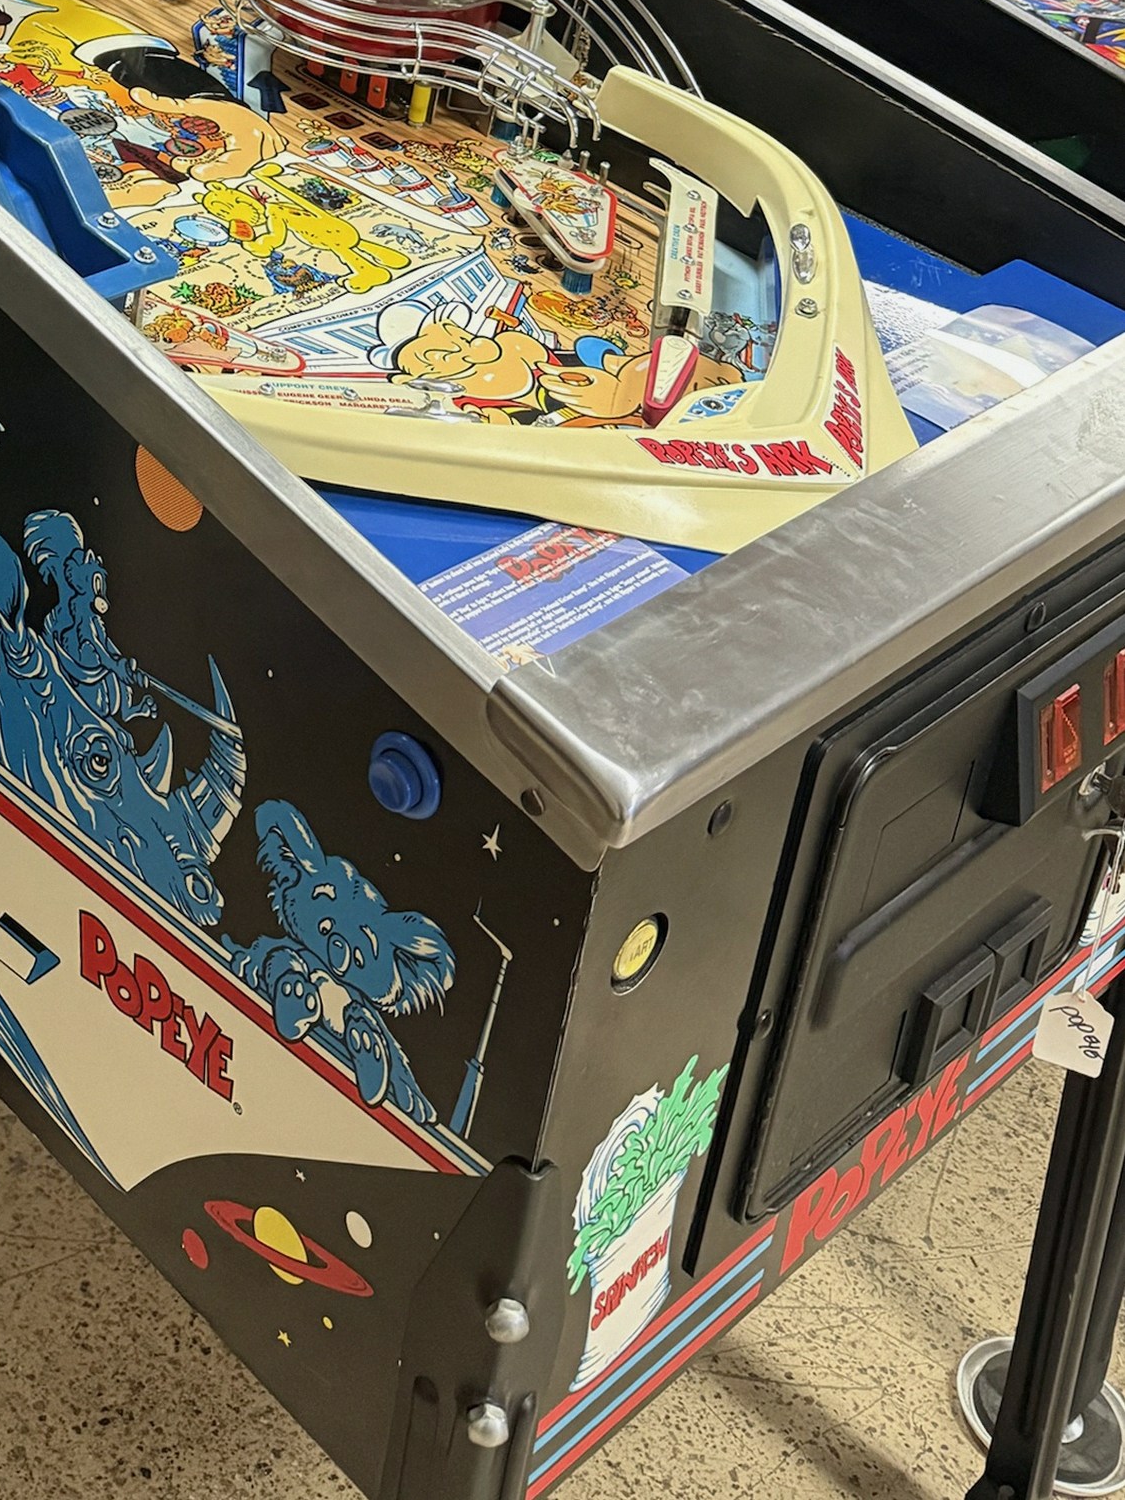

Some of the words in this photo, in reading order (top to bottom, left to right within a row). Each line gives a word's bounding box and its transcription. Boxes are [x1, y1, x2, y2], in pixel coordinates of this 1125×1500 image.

[63, 112, 103, 125] SAVE
[69, 116, 113, 132] OLIVE
[278, 317, 322, 332] COMPLETE
[375, 297, 394, 309] BEGIN
[397, 279, 427, 298] STAMPEDE
[268, 382, 315, 391] UPPORT
[318, 384, 351, 392] CREW
[835, 346, 859, 396] ARK
[635, 436, 759, 476] POPEYE'S
[751, 440, 833, 477] ARK
[626, 934, 655, 964] ART
[79, 909, 235, 1103] POPEYE
[778, 1051, 973, 1277] POPEYE
[591, 1225, 672, 1332] SPINACH
